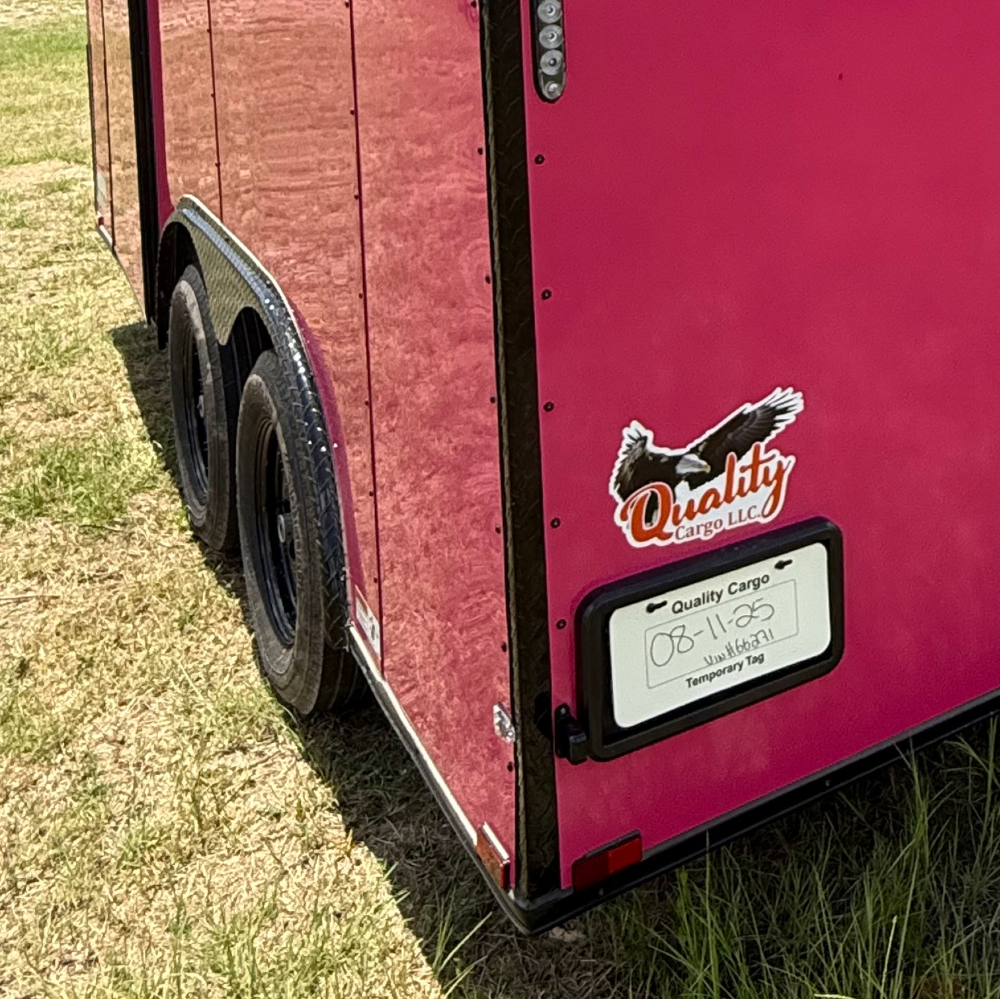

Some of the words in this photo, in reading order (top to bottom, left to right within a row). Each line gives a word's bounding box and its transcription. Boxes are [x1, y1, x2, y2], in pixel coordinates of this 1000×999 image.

[620, 442, 791, 542] Quality
[674, 517, 724, 541] Cargo
[727, 504, 761, 527] LLC.
[671, 588, 724, 615] Quality
[727, 573, 770, 596] Cargo
[650, 597, 775, 667] 08-11-25
[685, 659, 744, 689] Temporary
[745, 652, 765, 666] Tag
